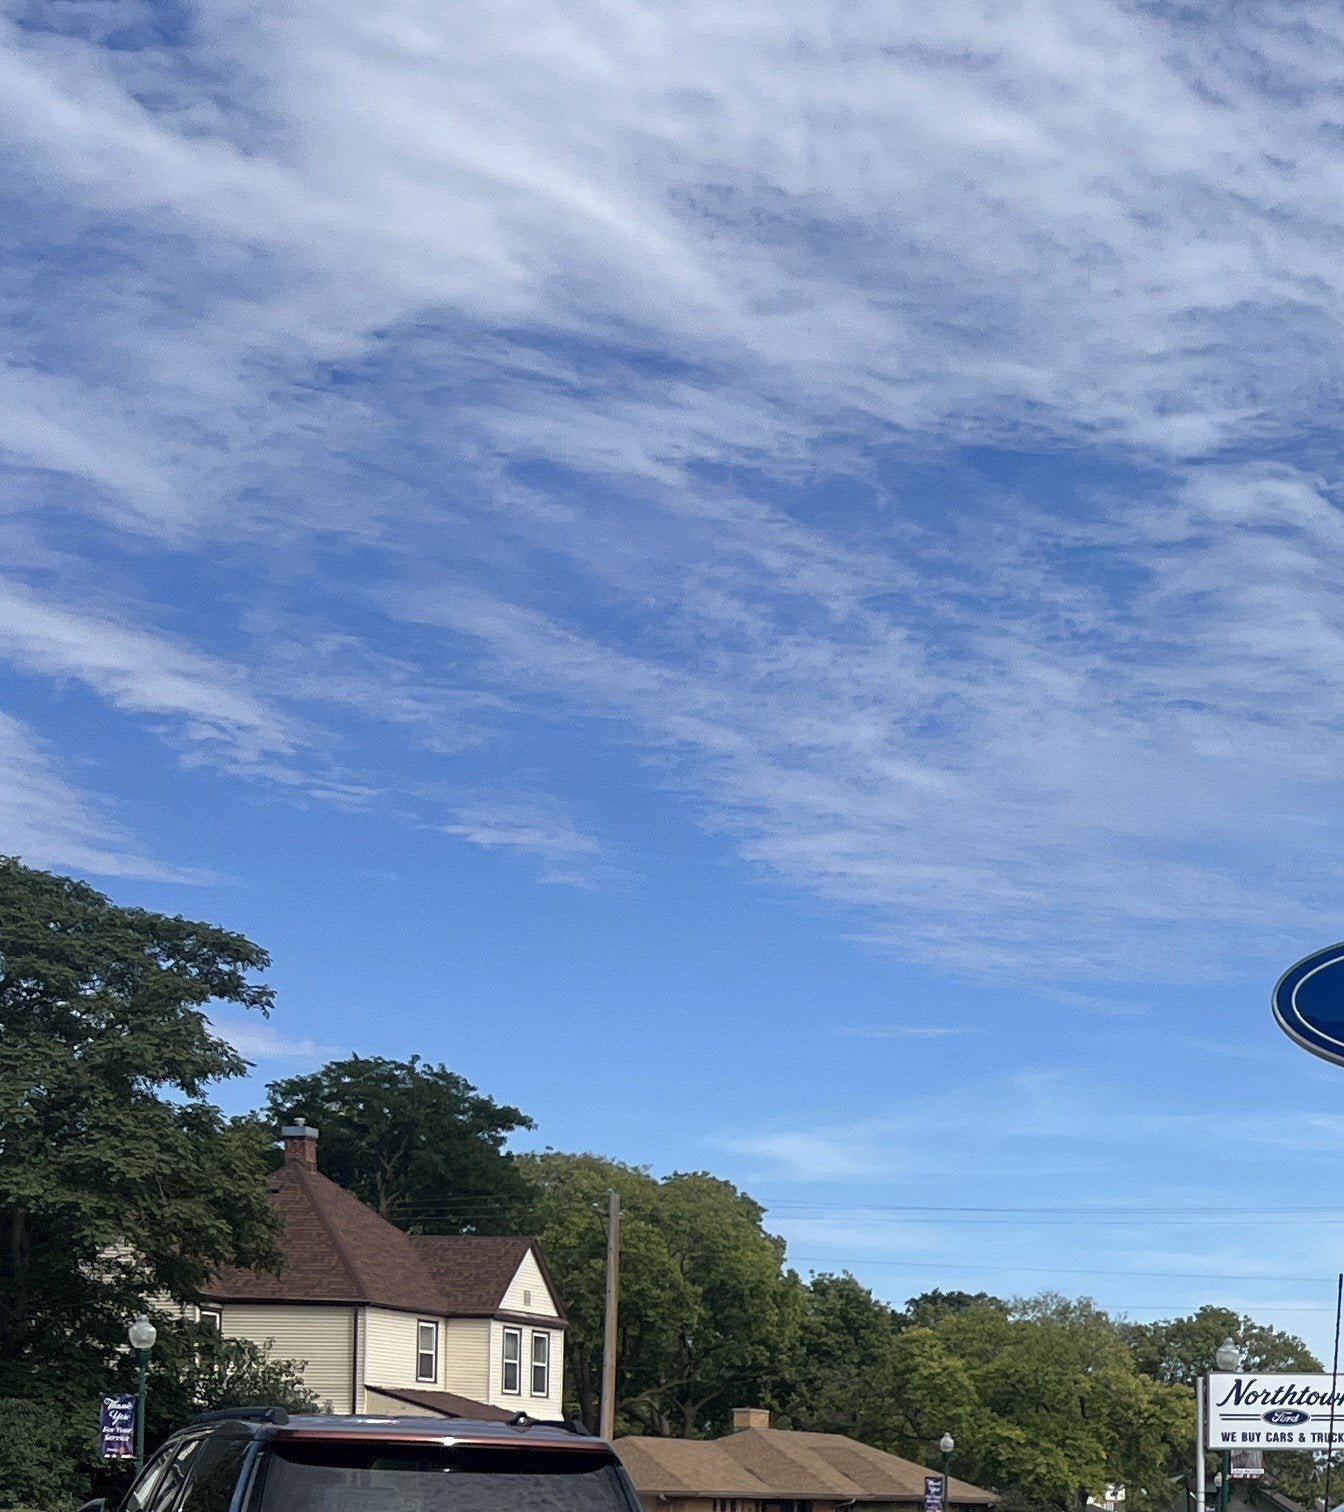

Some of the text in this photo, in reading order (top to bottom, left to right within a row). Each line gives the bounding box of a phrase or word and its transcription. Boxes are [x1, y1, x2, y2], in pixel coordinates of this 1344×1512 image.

[1270, 1411, 1301, 1424] Ford
[1221, 1432, 1237, 1443] WE
[1241, 1432, 1262, 1443] BUY
[1266, 1432, 1294, 1443] CARS
[1298, 1432, 1306, 1443] &
